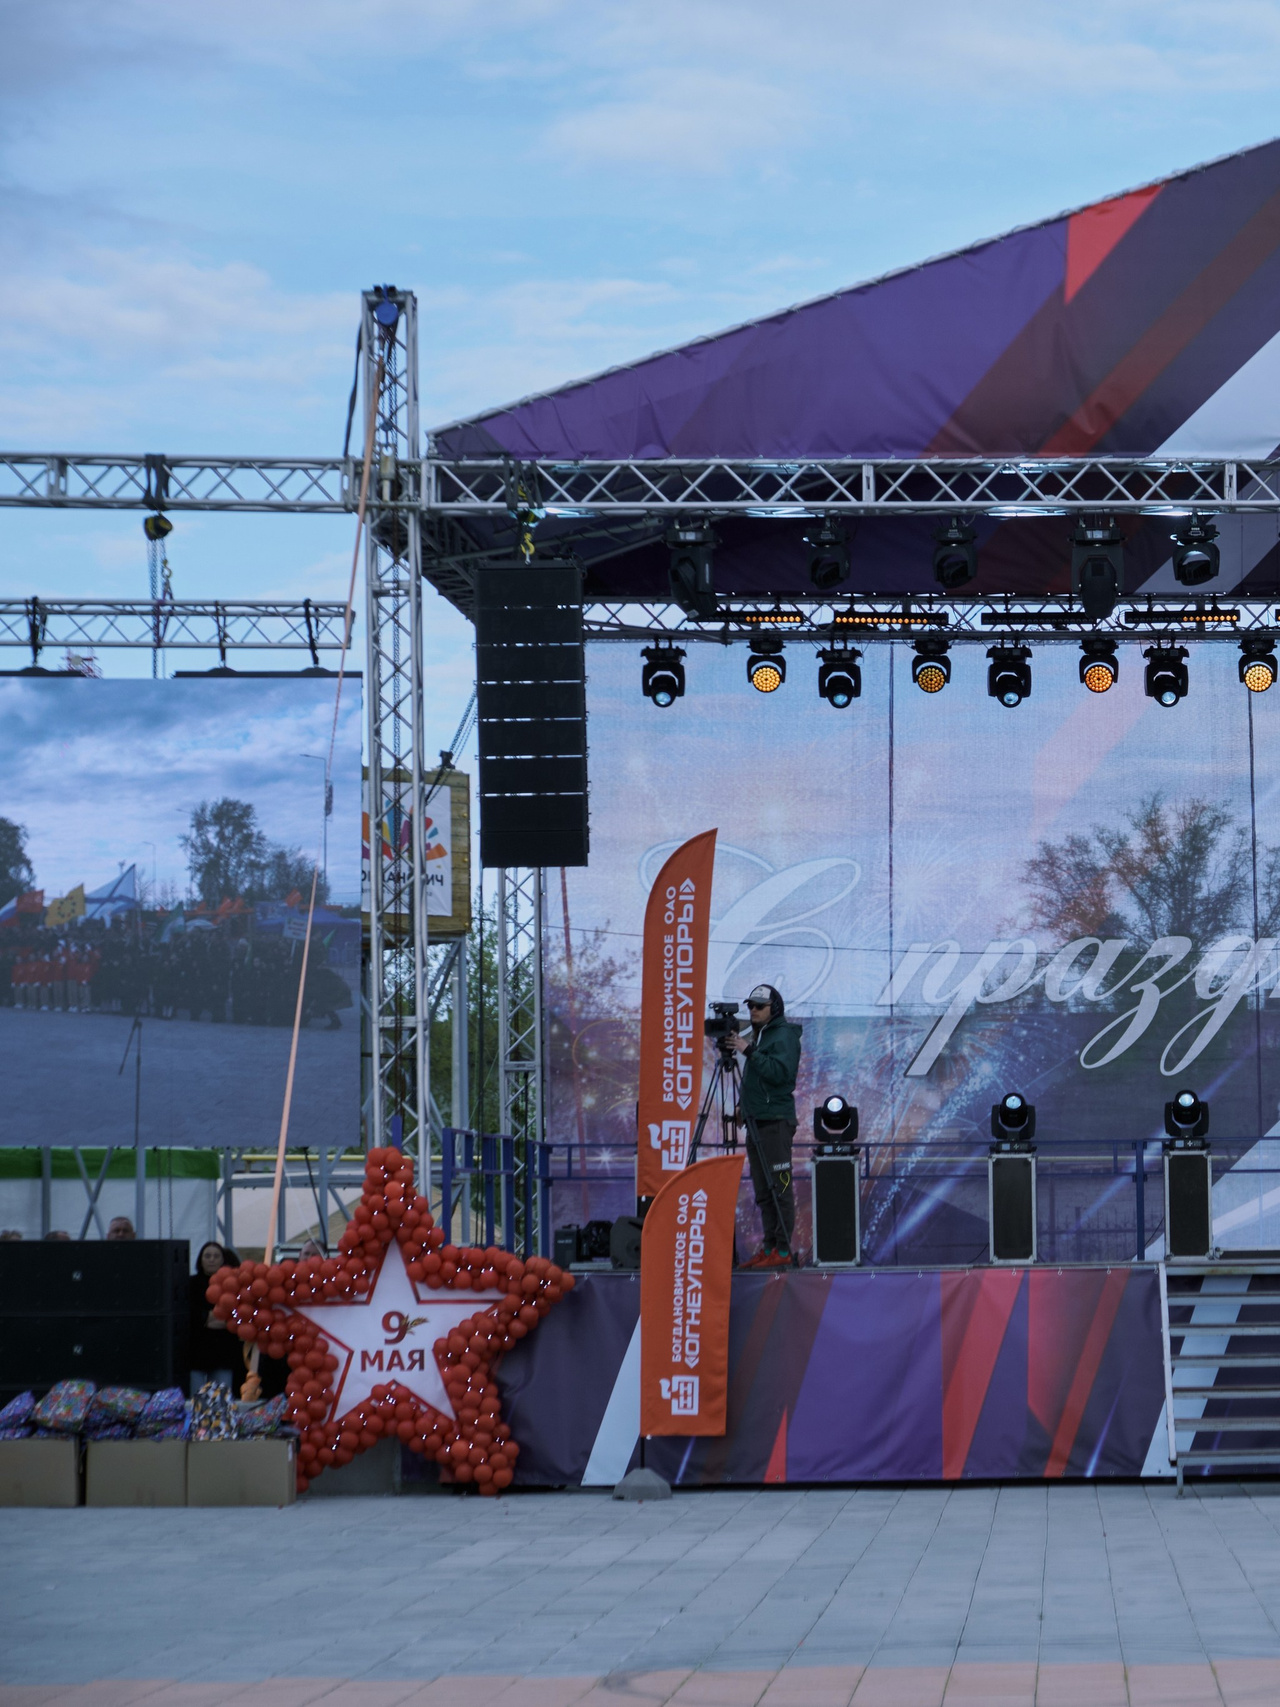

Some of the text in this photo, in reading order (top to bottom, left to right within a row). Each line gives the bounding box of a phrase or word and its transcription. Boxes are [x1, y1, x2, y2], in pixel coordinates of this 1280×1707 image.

[638, 839, 862, 1037] С
[663, 886, 677, 1103] БОГДАНОВИЧСКОЕ ОАО
[676, 877, 696, 1111] «ОГНЕУПОРЫ»
[360, 1348, 425, 1373] МАЯ
[381, 1310, 410, 1346] 9
[671, 1194, 690, 1363] БОГДАНОВИЧСКОЕ ОАО
[684, 1188, 708, 1369] «ОГНЕУПОРЫ»
